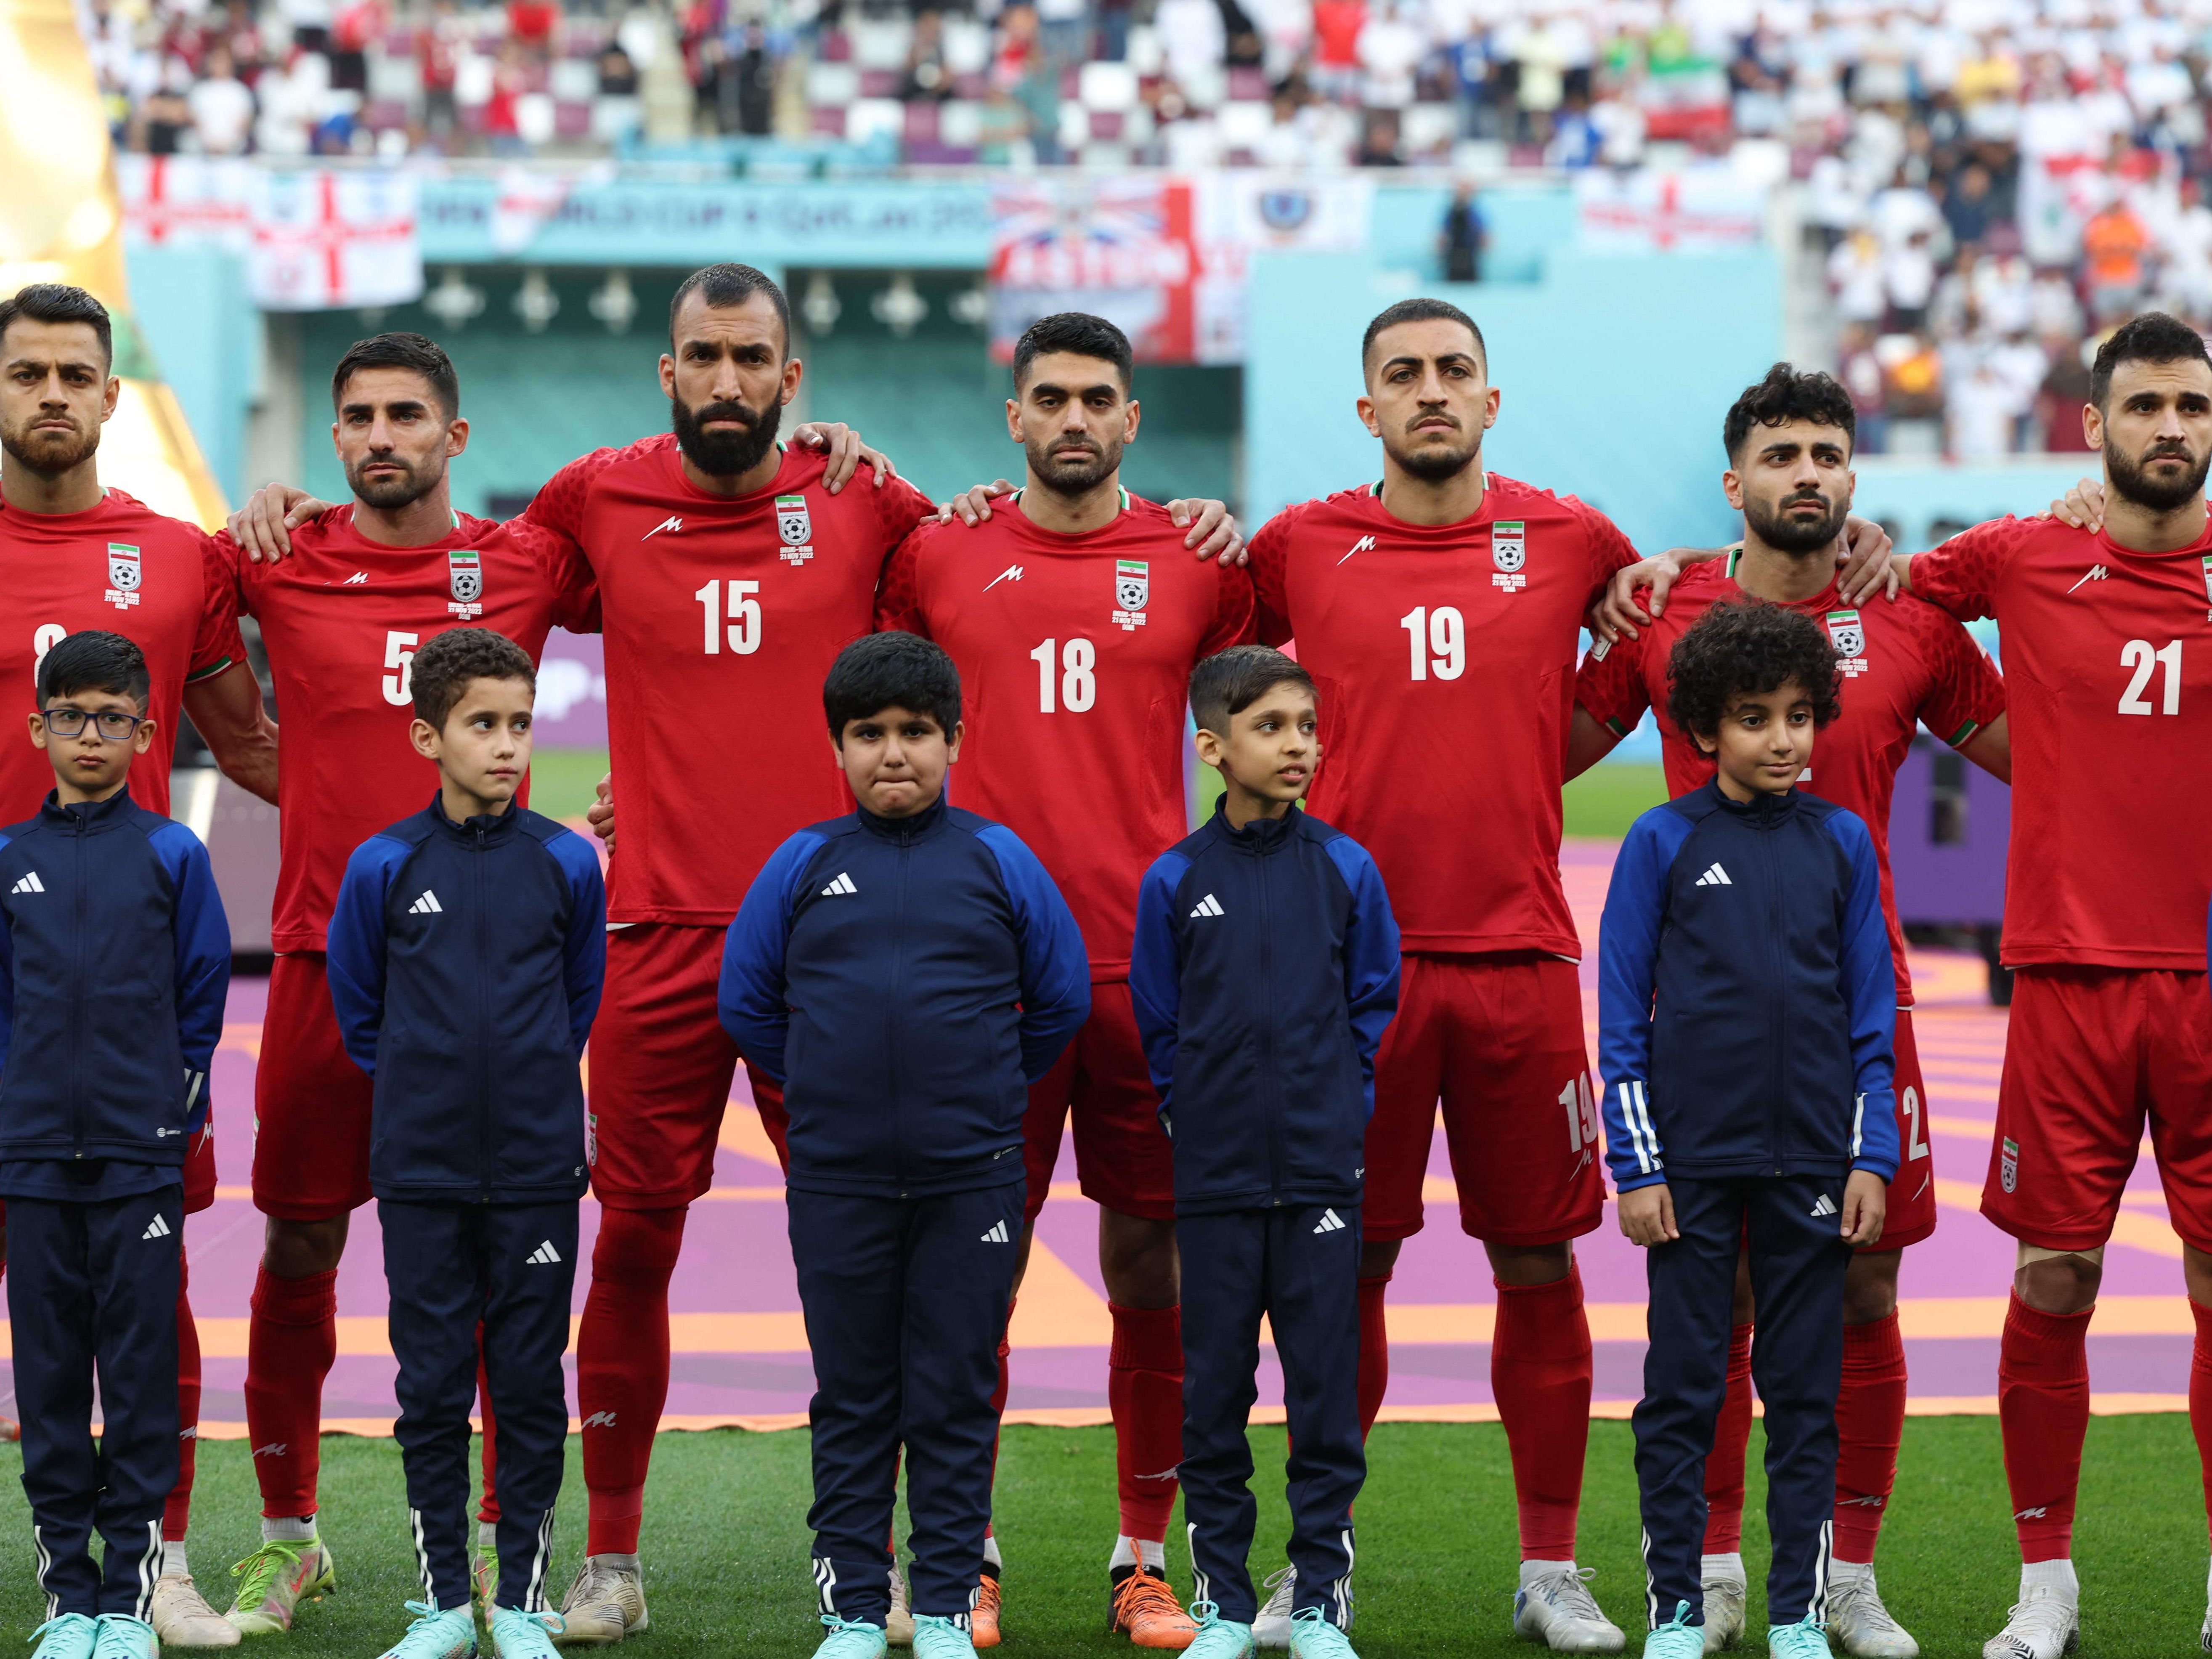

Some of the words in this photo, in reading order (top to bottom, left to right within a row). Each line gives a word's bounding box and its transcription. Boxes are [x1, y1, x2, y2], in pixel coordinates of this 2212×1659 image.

[695, 579, 761, 655] 15
[1400, 606, 1466, 681] 19
[382, 630, 419, 706] 5
[1030, 638, 1096, 713] 18
[2118, 639, 2183, 715] 21
[1558, 1070, 1598, 1153] 19
[1903, 1086, 1929, 1161] 2
